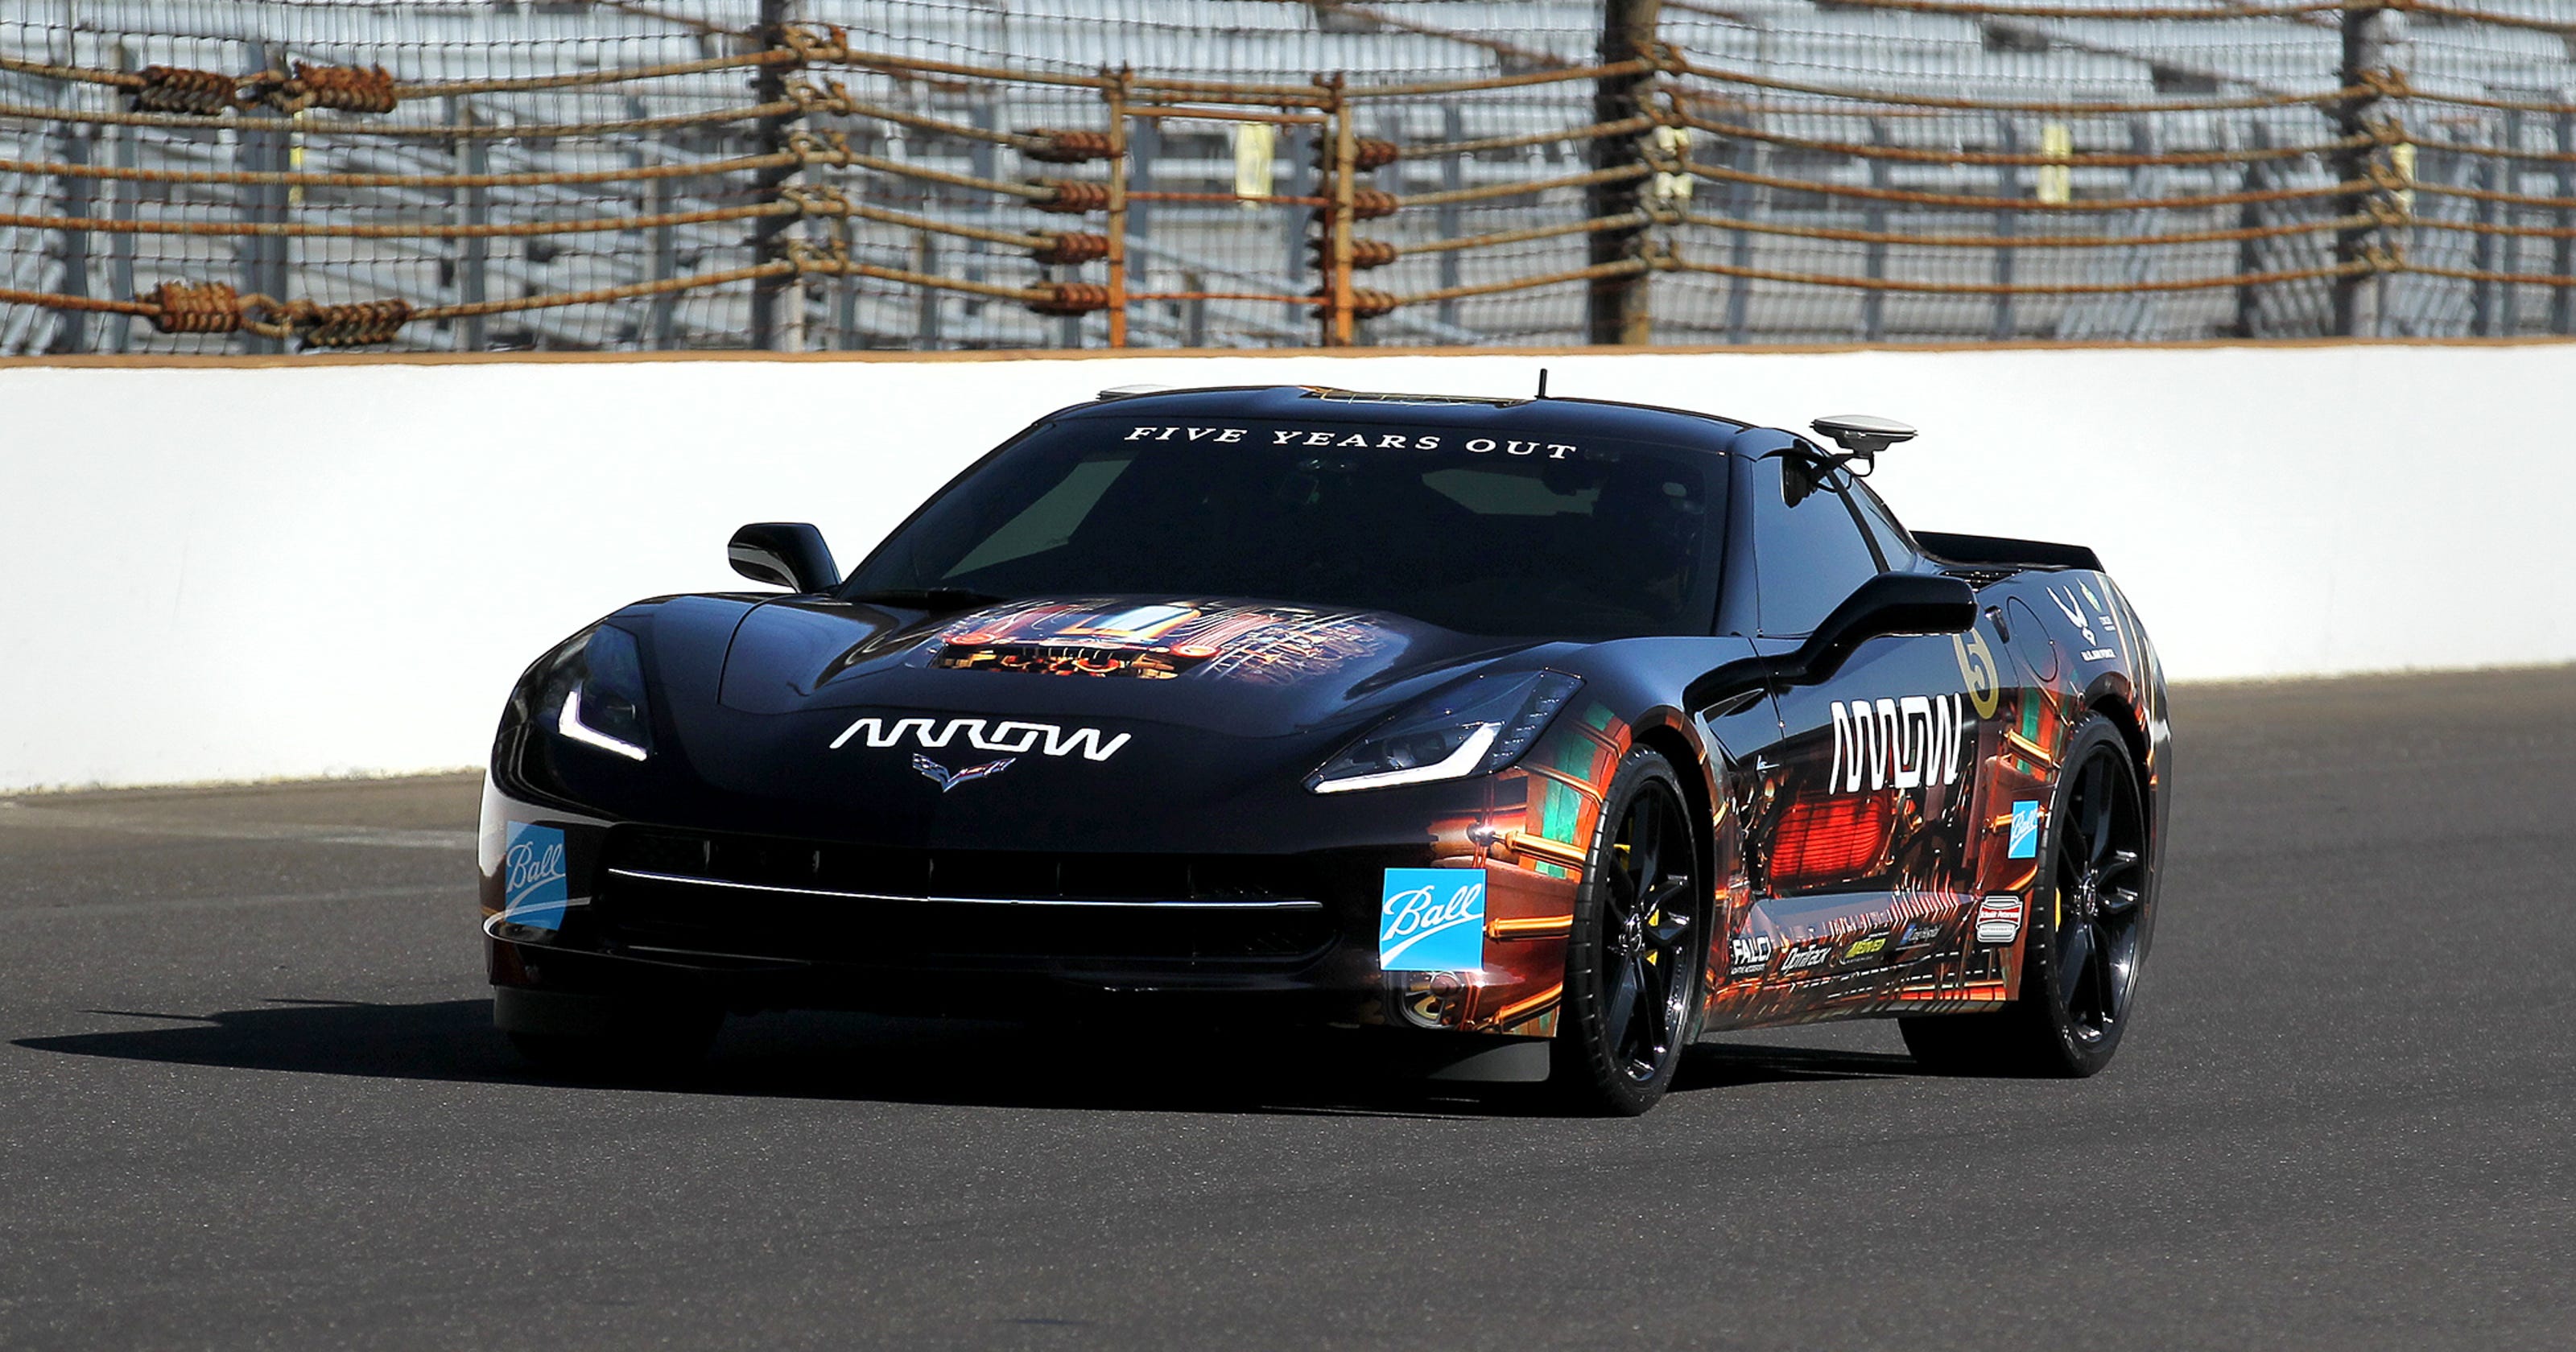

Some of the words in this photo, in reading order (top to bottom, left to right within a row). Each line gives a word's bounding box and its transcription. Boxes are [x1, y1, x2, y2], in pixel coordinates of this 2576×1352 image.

[1124, 427, 1247, 443] FIVE
[1273, 431, 1440, 450] YEARS
[1465, 439, 1577, 460] OUT
[830, 718, 1132, 761] ARROW
[1828, 692, 1963, 796] ARROW
[2010, 807, 2038, 842] Ball
[506, 841, 566, 895] Ball
[1381, 883, 1485, 942] Ball
